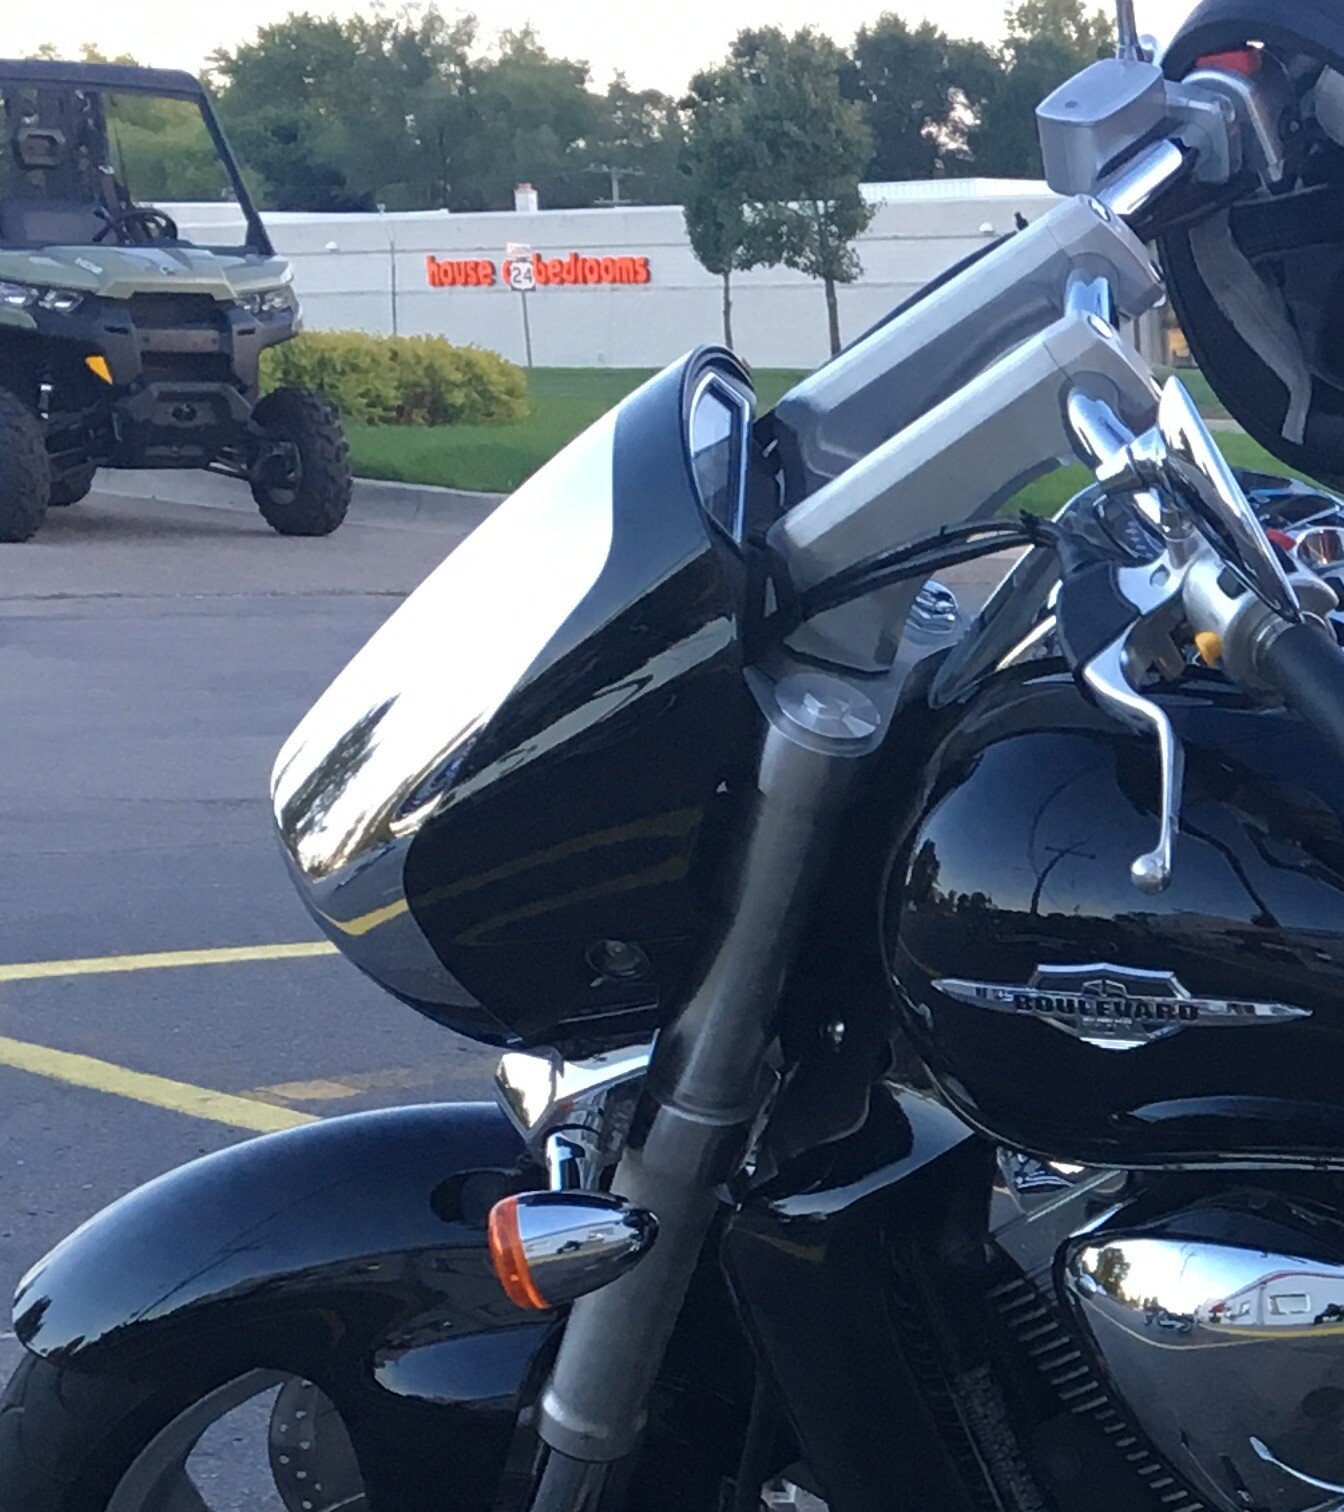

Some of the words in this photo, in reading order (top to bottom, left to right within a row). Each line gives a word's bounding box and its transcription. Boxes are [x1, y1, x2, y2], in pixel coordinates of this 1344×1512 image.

[426, 254, 495, 286] house
[531, 251, 650, 285] bedrooms
[512, 265, 533, 284] 24
[1013, 993, 1199, 1021] BOULEVARD
